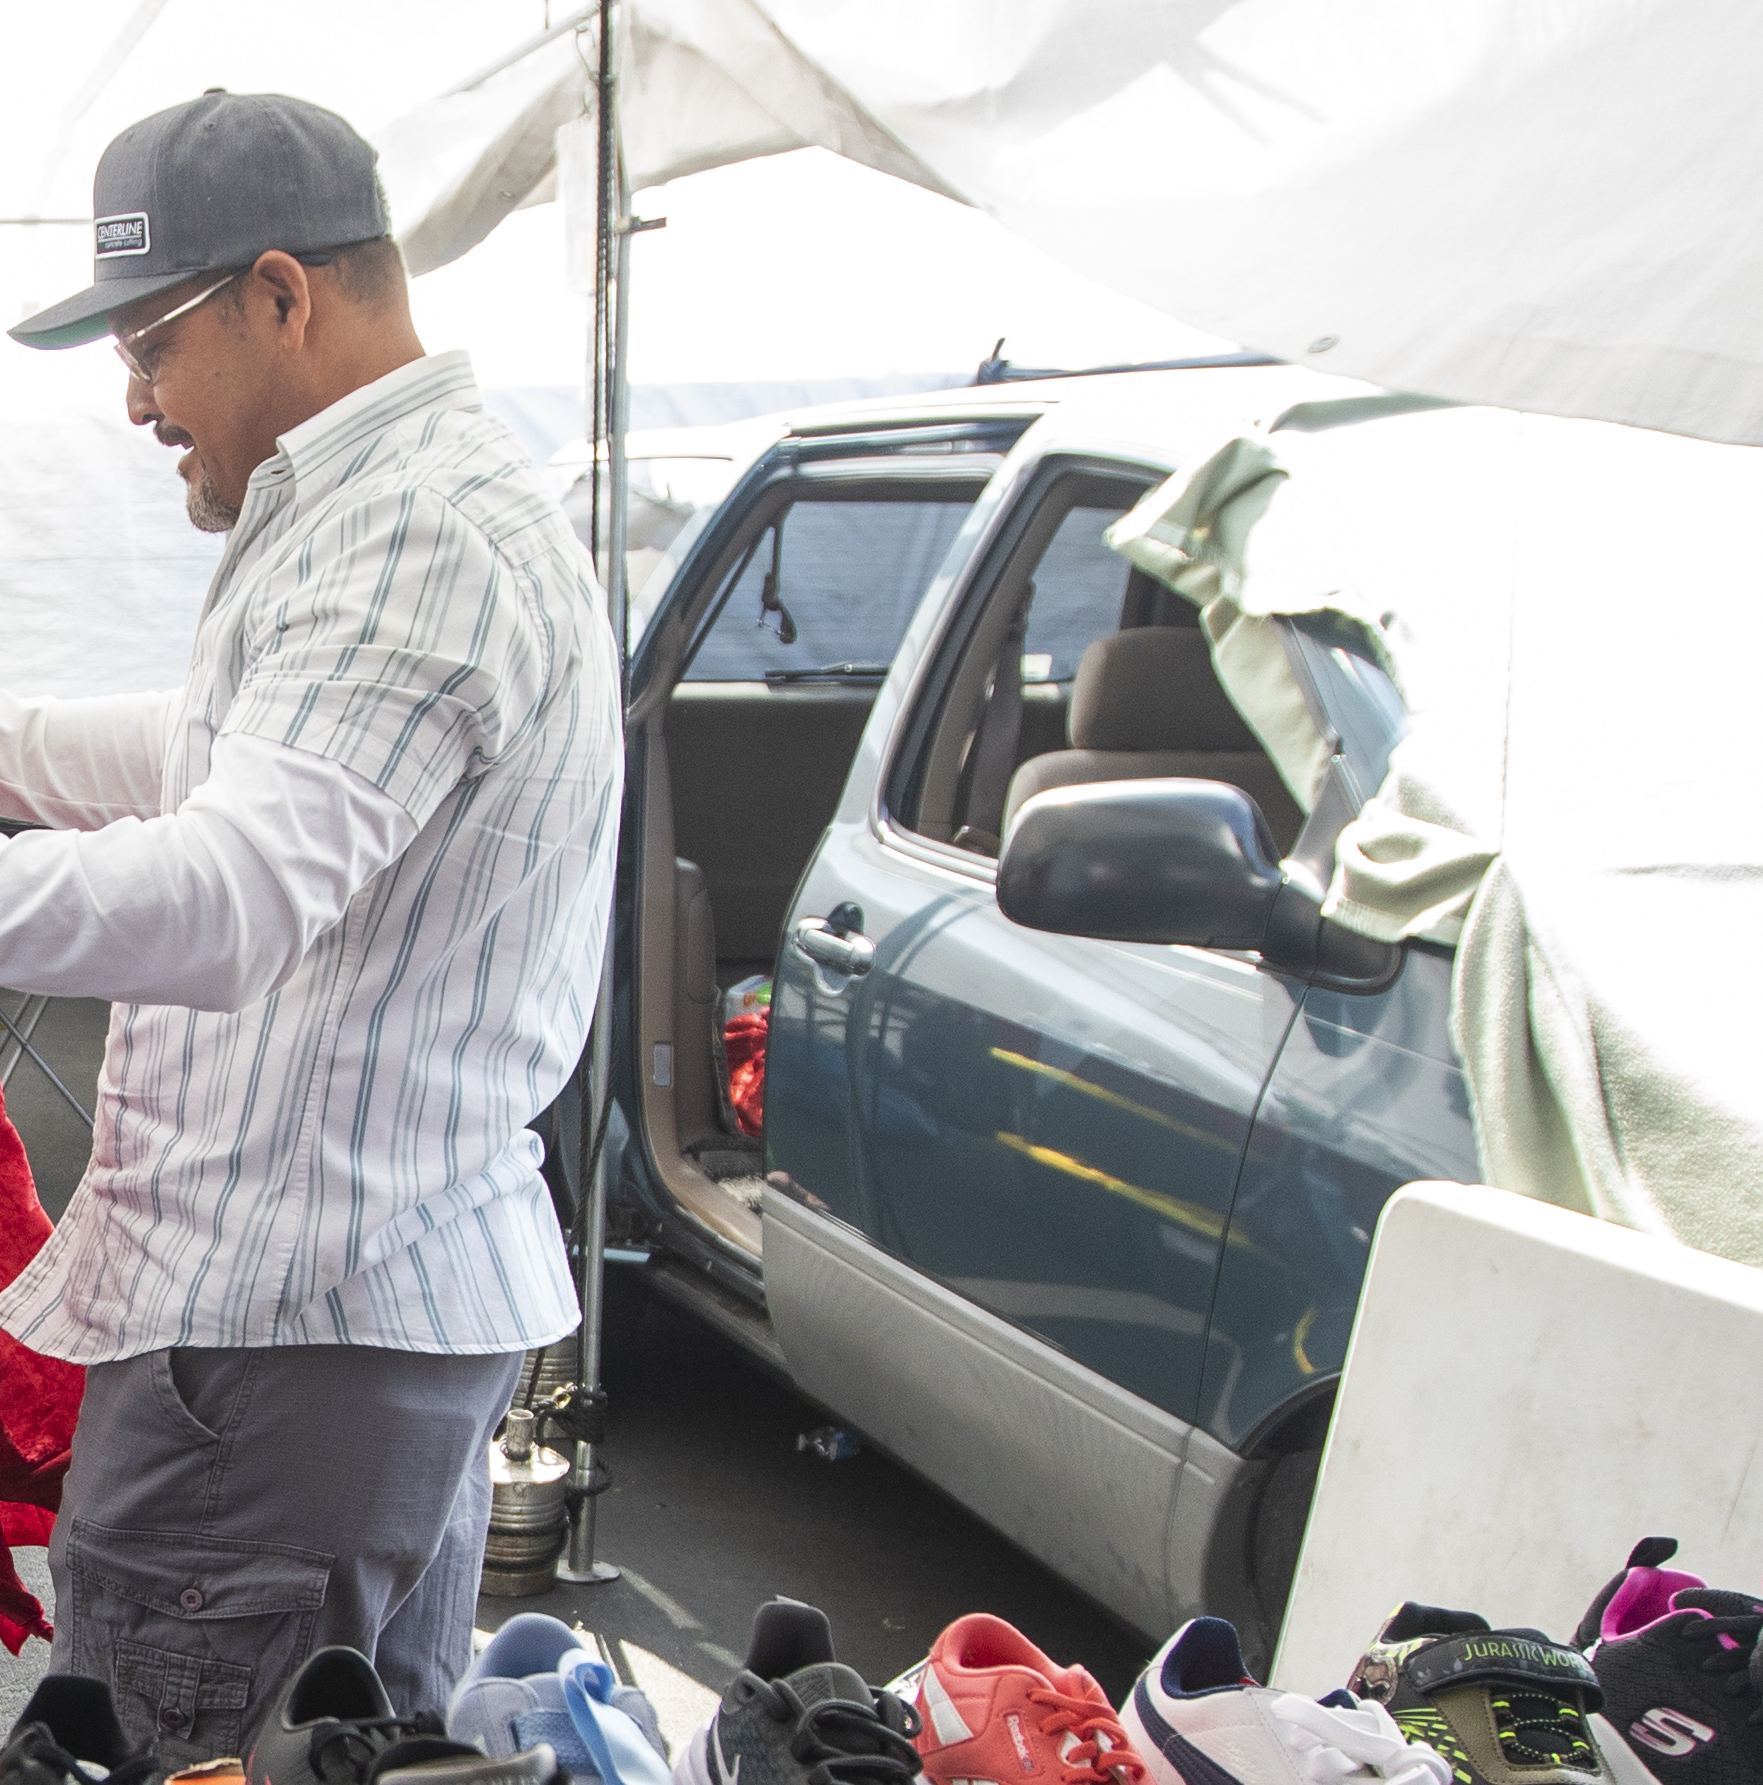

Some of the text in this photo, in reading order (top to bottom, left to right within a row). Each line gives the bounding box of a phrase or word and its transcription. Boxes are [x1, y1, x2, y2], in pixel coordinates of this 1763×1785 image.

[97, 220, 143, 240] CENTERLINE
[1463, 1641, 1539, 1662] JURASSIC
[1006, 1714, 1031, 1760] Reebok
